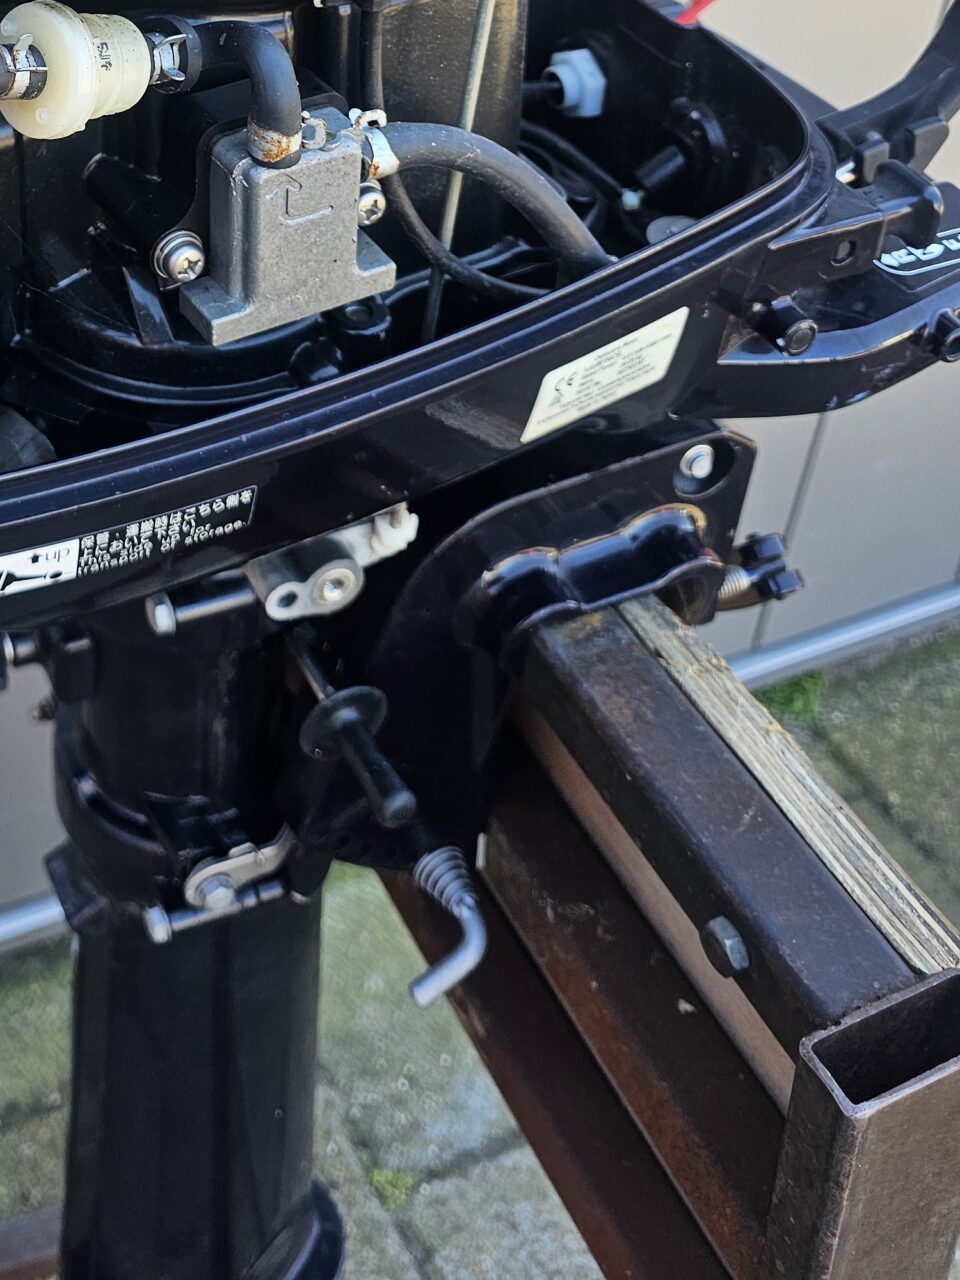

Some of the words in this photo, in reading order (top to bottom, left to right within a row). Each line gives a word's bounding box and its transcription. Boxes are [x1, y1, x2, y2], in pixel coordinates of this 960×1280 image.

[46, 547, 70, 562] up
[77, 547, 152, 577] transport
[79, 552, 112, 568] This
[119, 541, 153, 557] side
[161, 533, 181, 547] up
